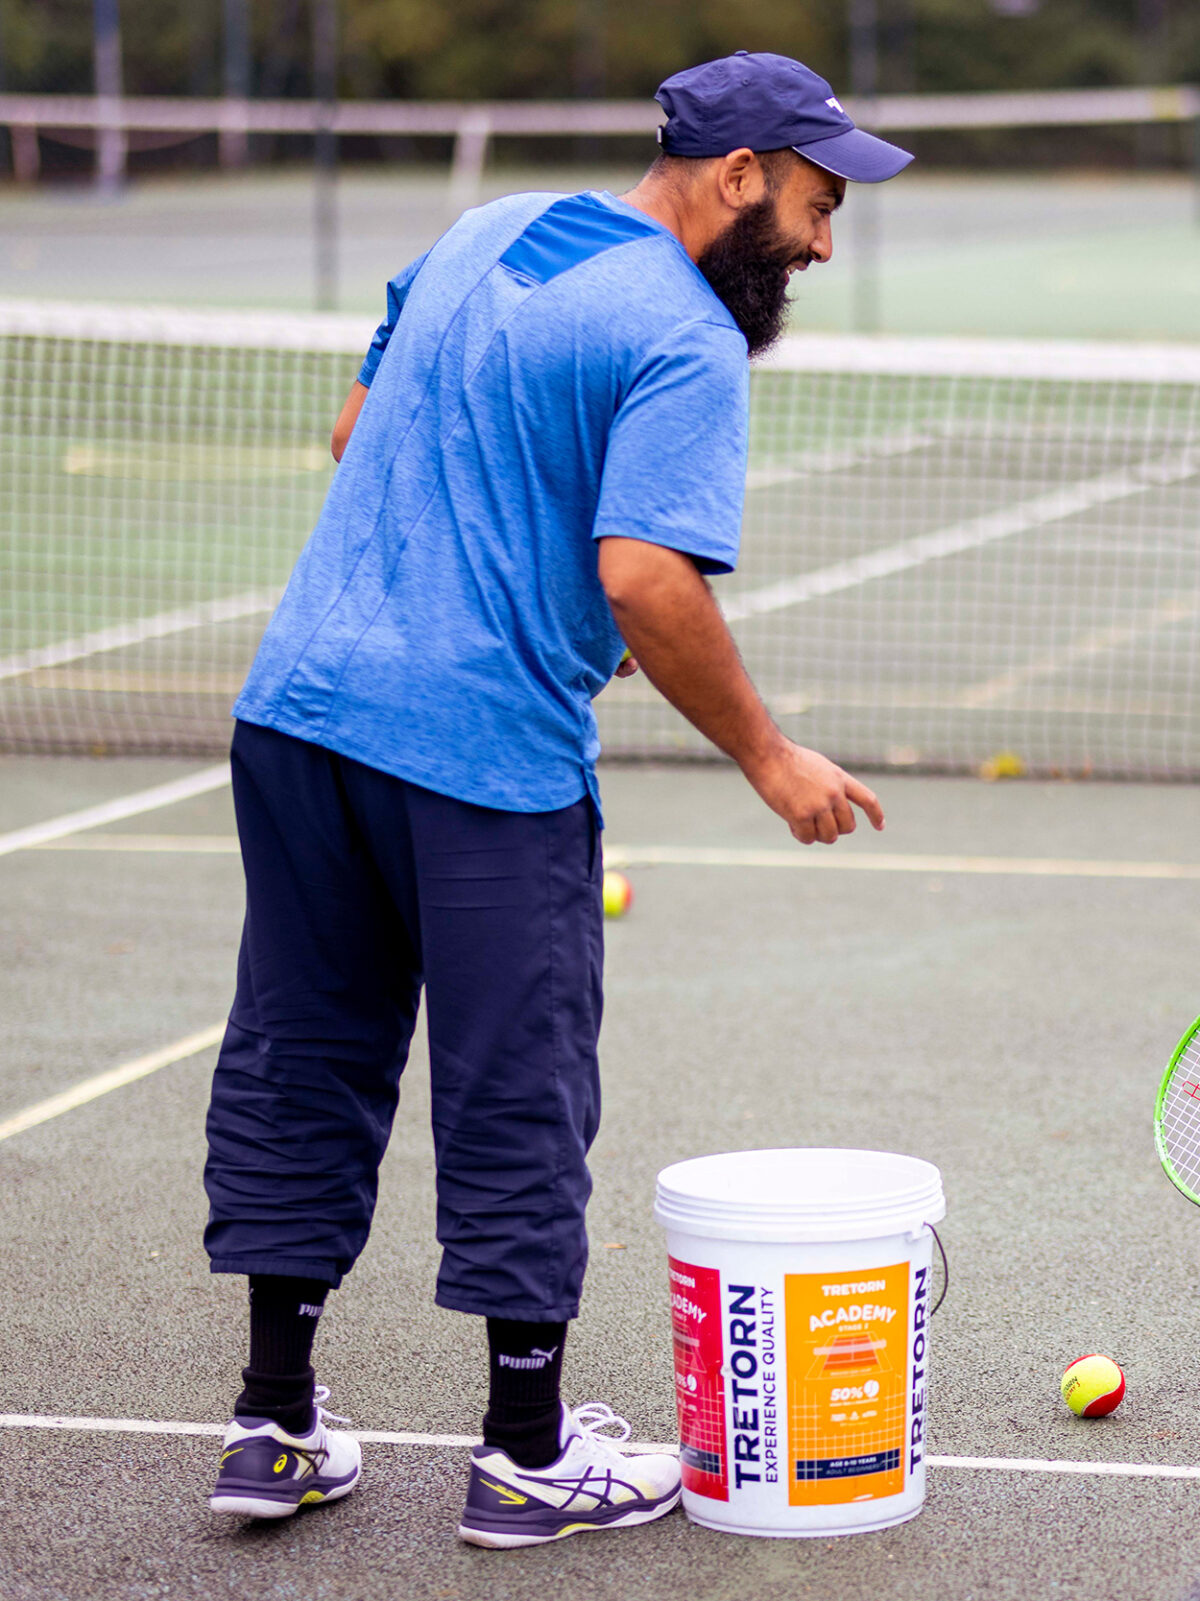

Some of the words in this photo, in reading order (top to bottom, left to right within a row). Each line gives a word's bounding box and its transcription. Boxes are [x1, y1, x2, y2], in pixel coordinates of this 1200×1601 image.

[761, 1287, 775, 1365] QUALITY
[809, 1304, 897, 1332] ACADEMY
[821, 1279, 886, 1297] TRETORN
[728, 1284, 761, 1489] TRETORN
[830, 1386, 864, 1402] 50%
[909, 1267, 927, 1475] TRETORN
[763, 1371, 778, 1483] EXPERIENCE
